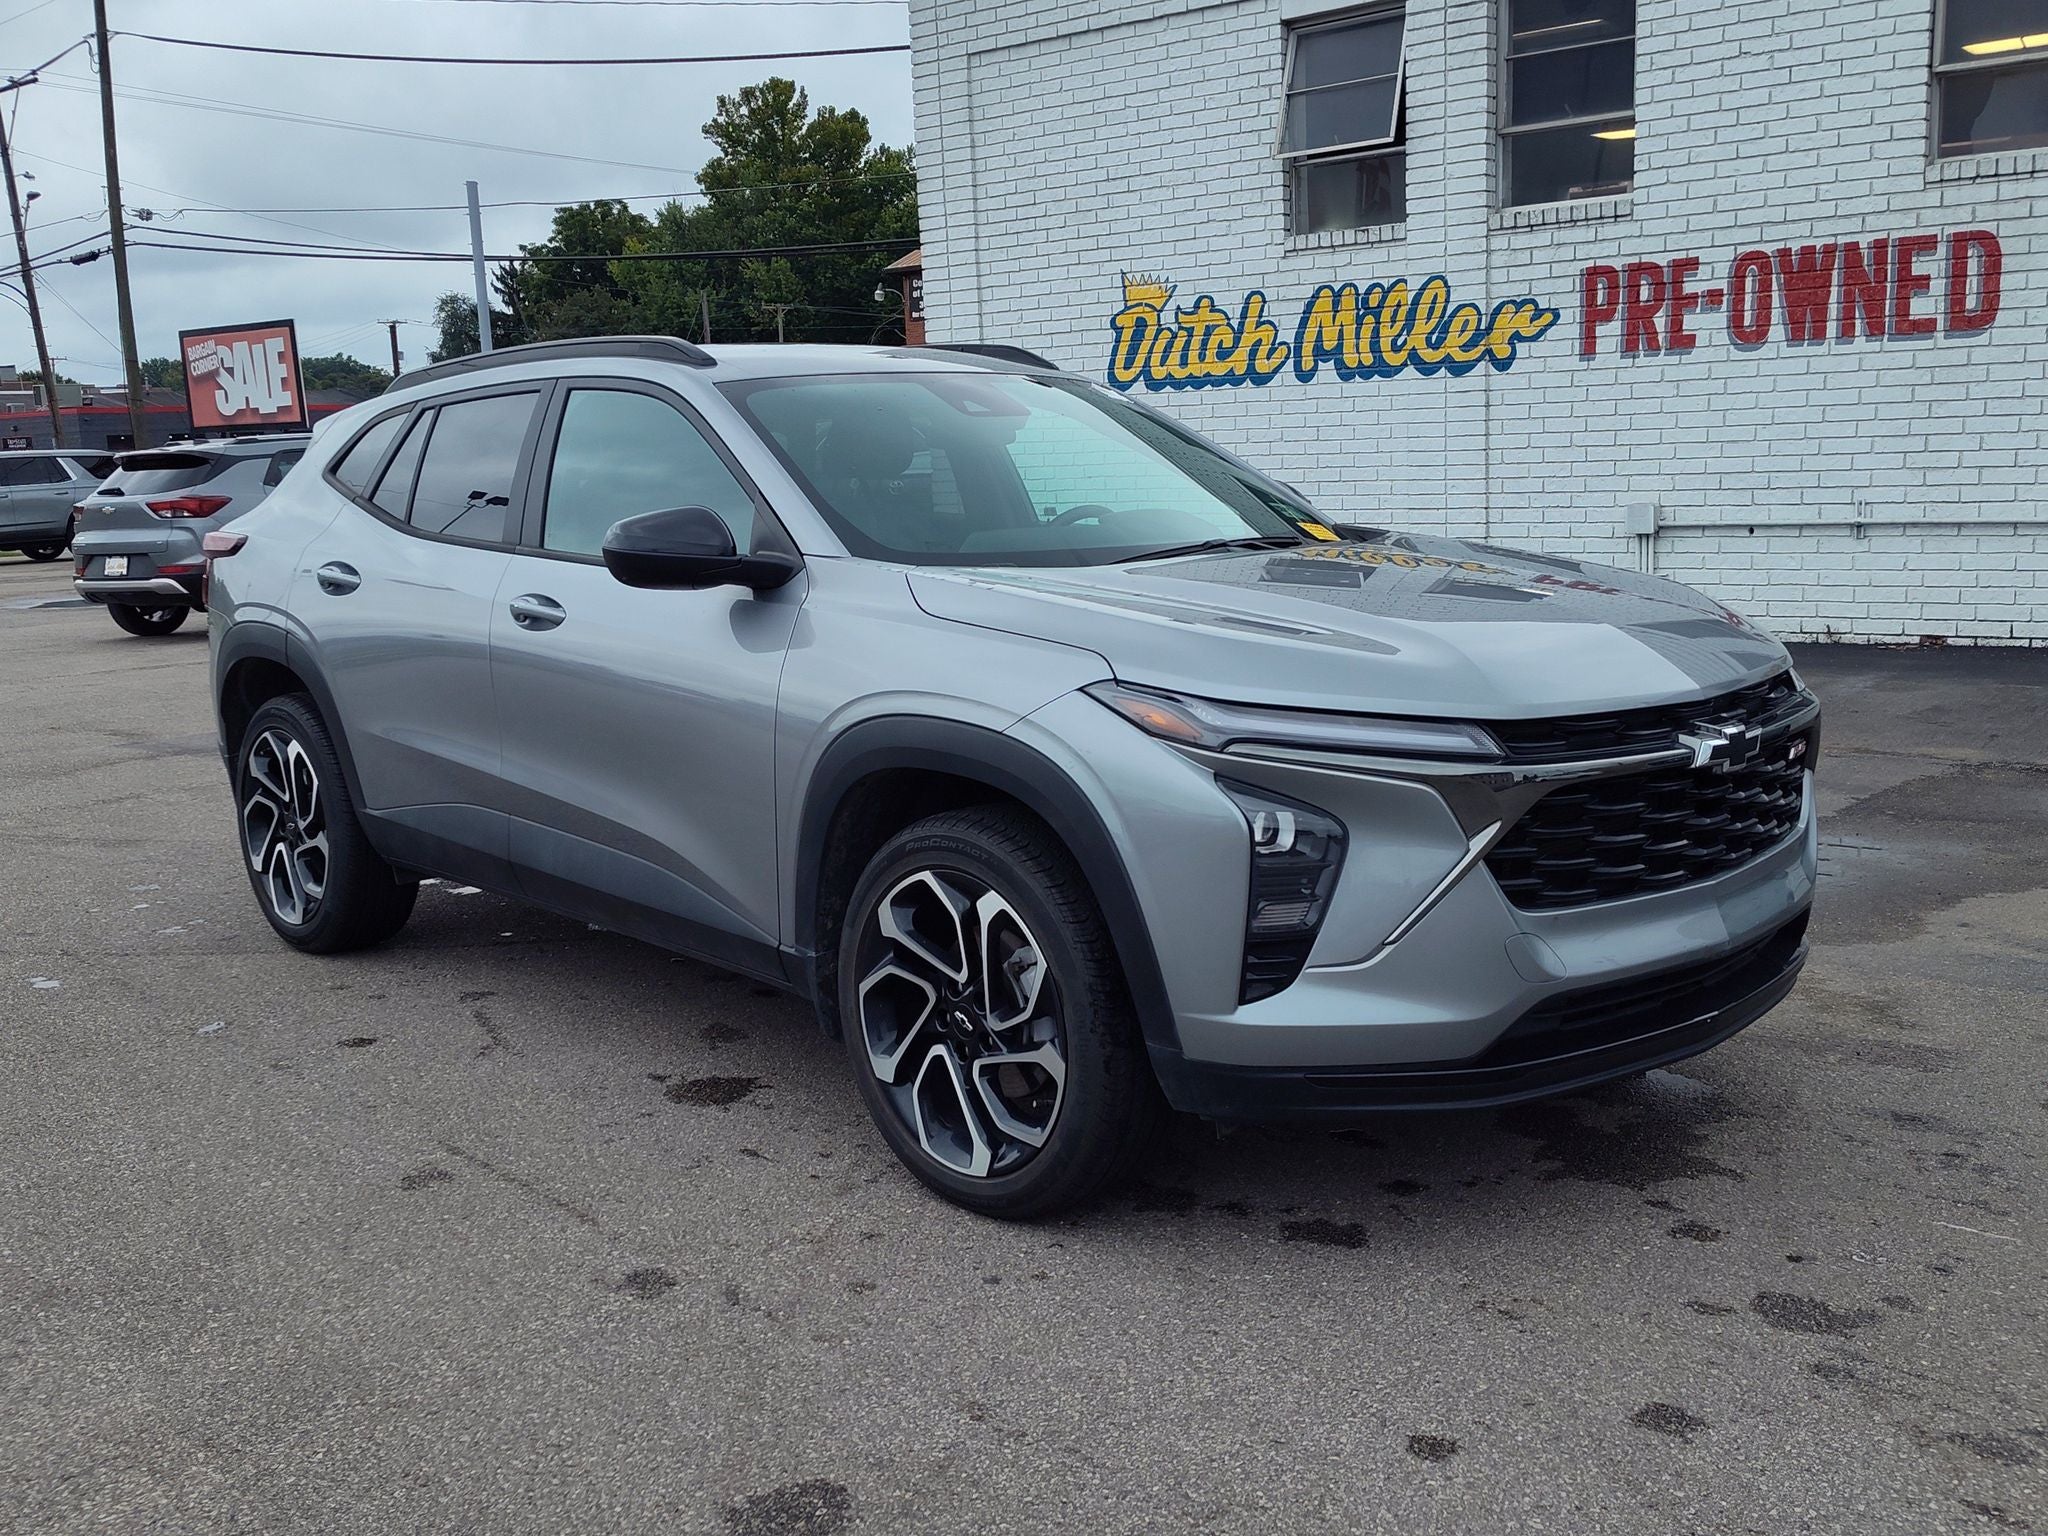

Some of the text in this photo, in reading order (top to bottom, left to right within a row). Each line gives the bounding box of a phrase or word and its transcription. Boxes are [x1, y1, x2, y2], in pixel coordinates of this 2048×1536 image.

[1109, 275, 1560, 391] Dutch Miller
[1579, 230, 2003, 361] PRE-OWNED
[187, 339, 216, 361] BARGAIN
[191, 354, 219, 377] CORNER
[215, 337, 292, 416] SALE
